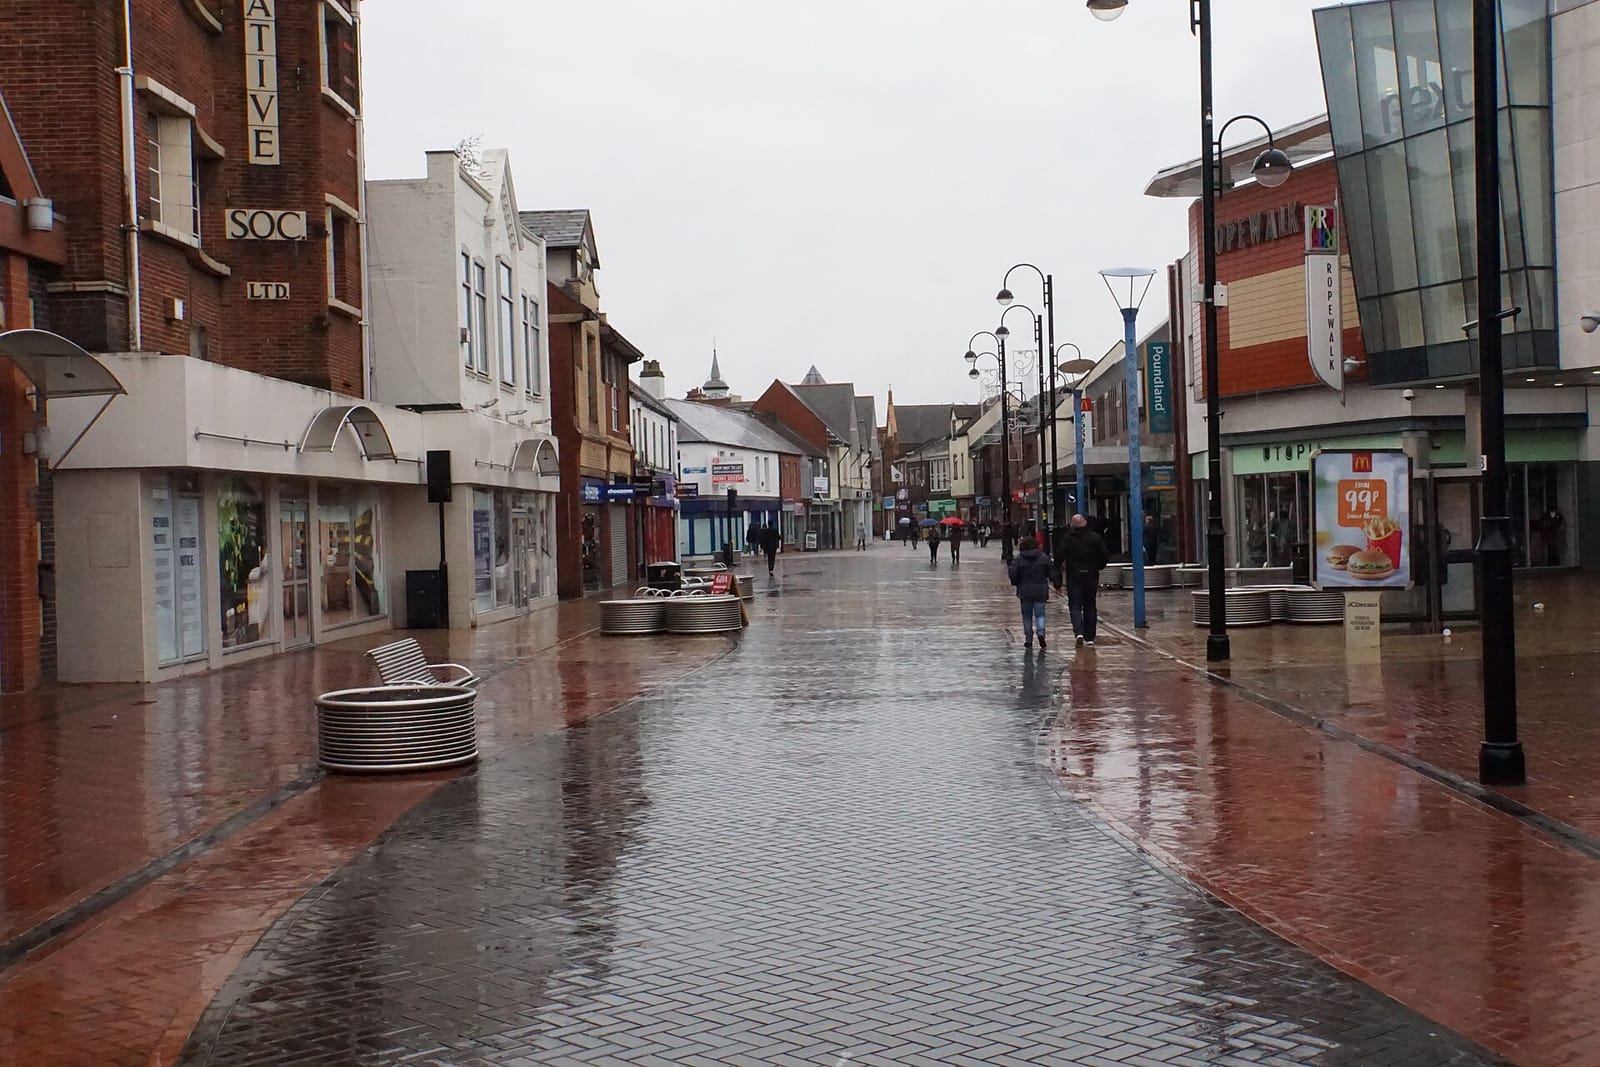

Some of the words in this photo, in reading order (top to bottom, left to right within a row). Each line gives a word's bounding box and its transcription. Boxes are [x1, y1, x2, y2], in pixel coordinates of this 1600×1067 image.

[249, 282, 289, 299] LTD.
[1326, 262, 1335, 371] ROPEWALK
[1152, 346, 1166, 412] Poundland
